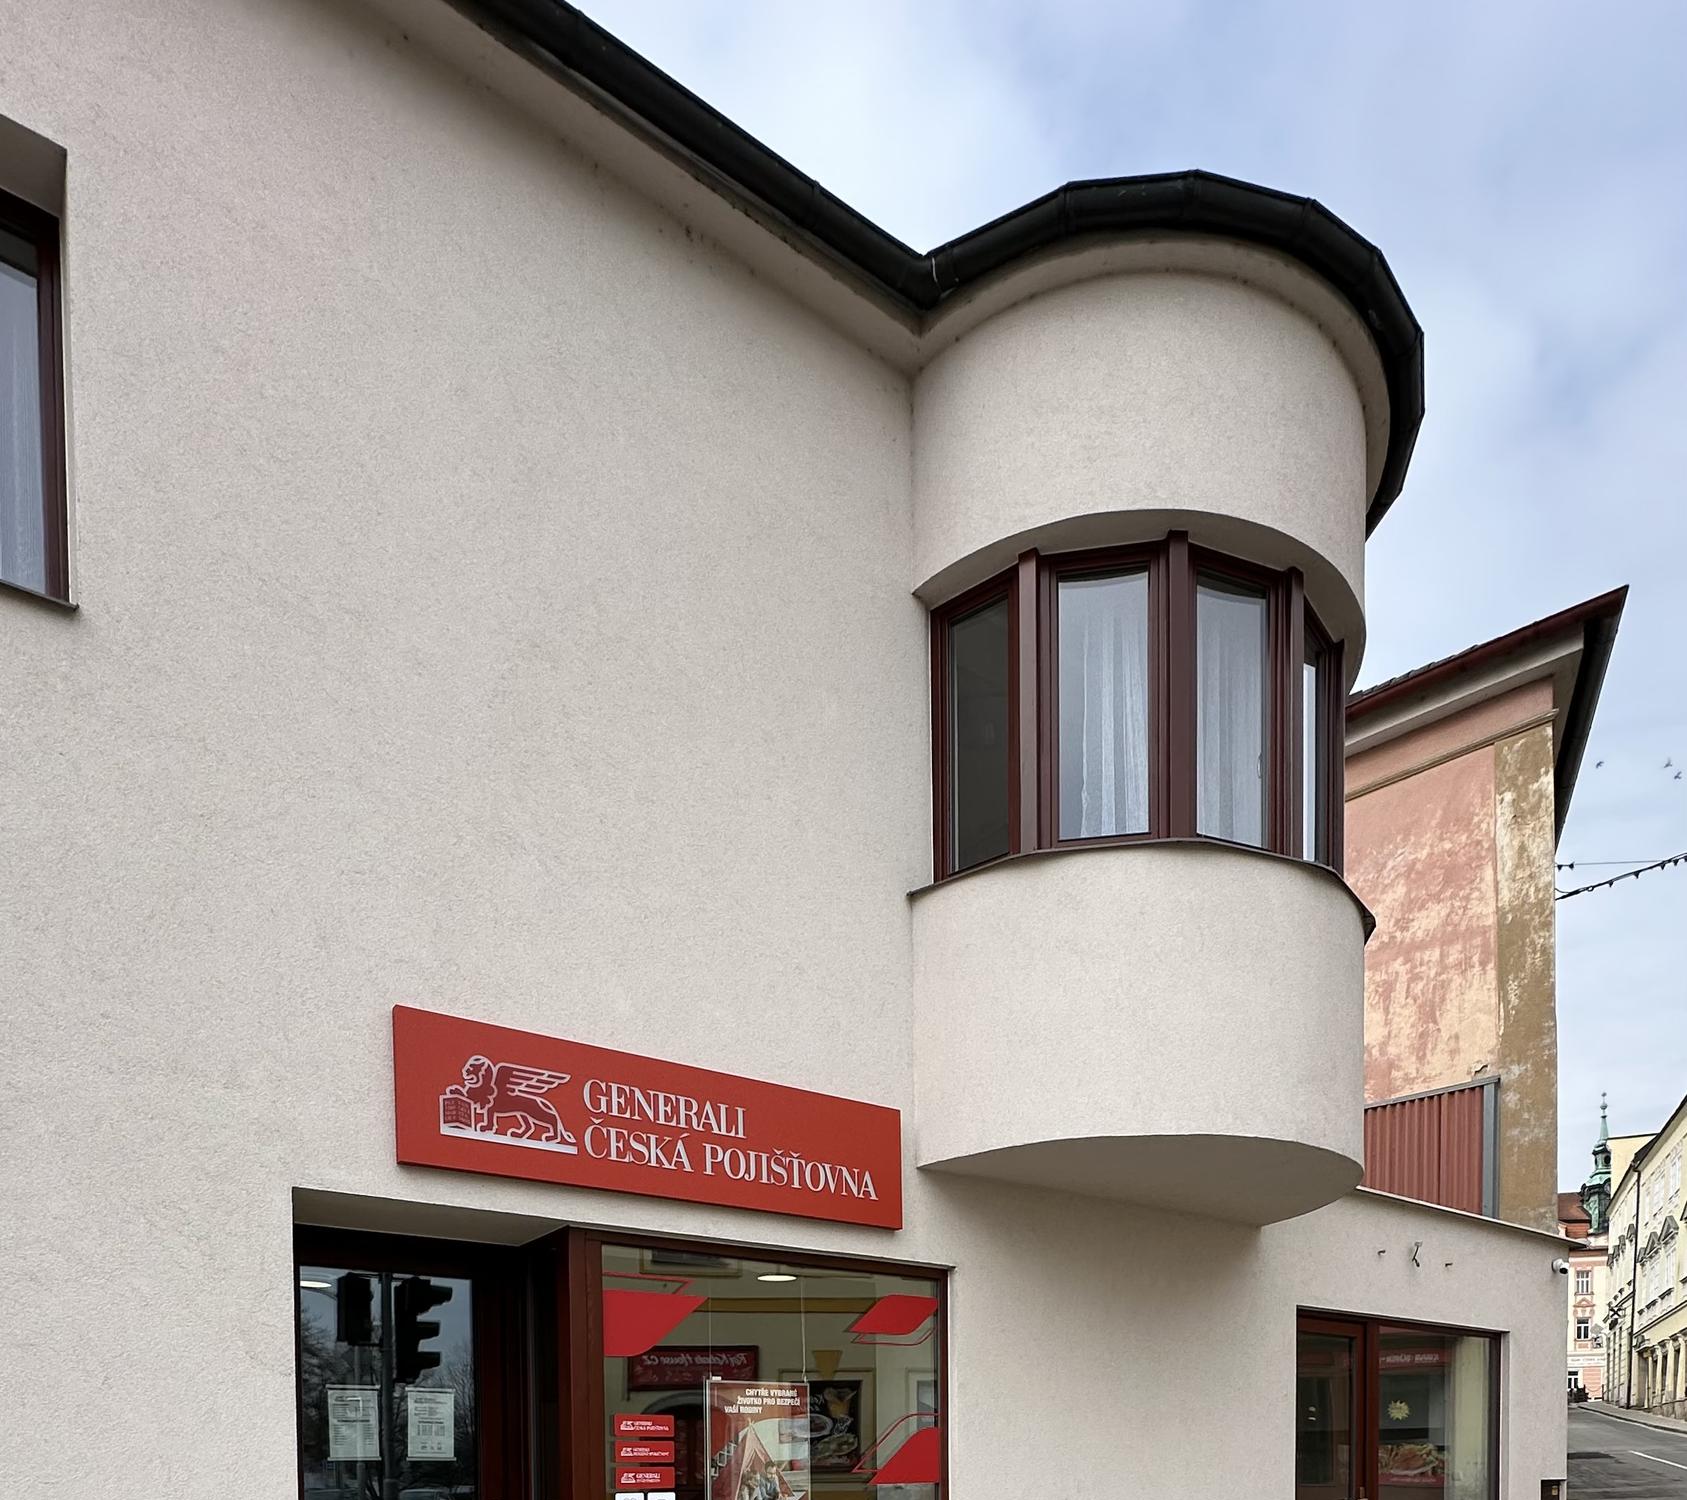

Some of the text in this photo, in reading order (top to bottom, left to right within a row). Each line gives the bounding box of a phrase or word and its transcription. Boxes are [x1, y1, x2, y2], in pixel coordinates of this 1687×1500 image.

[583, 1079, 746, 1139] GENERALI
[583, 1117, 879, 1201] ČESKÁ POJIŠŤOVNA
